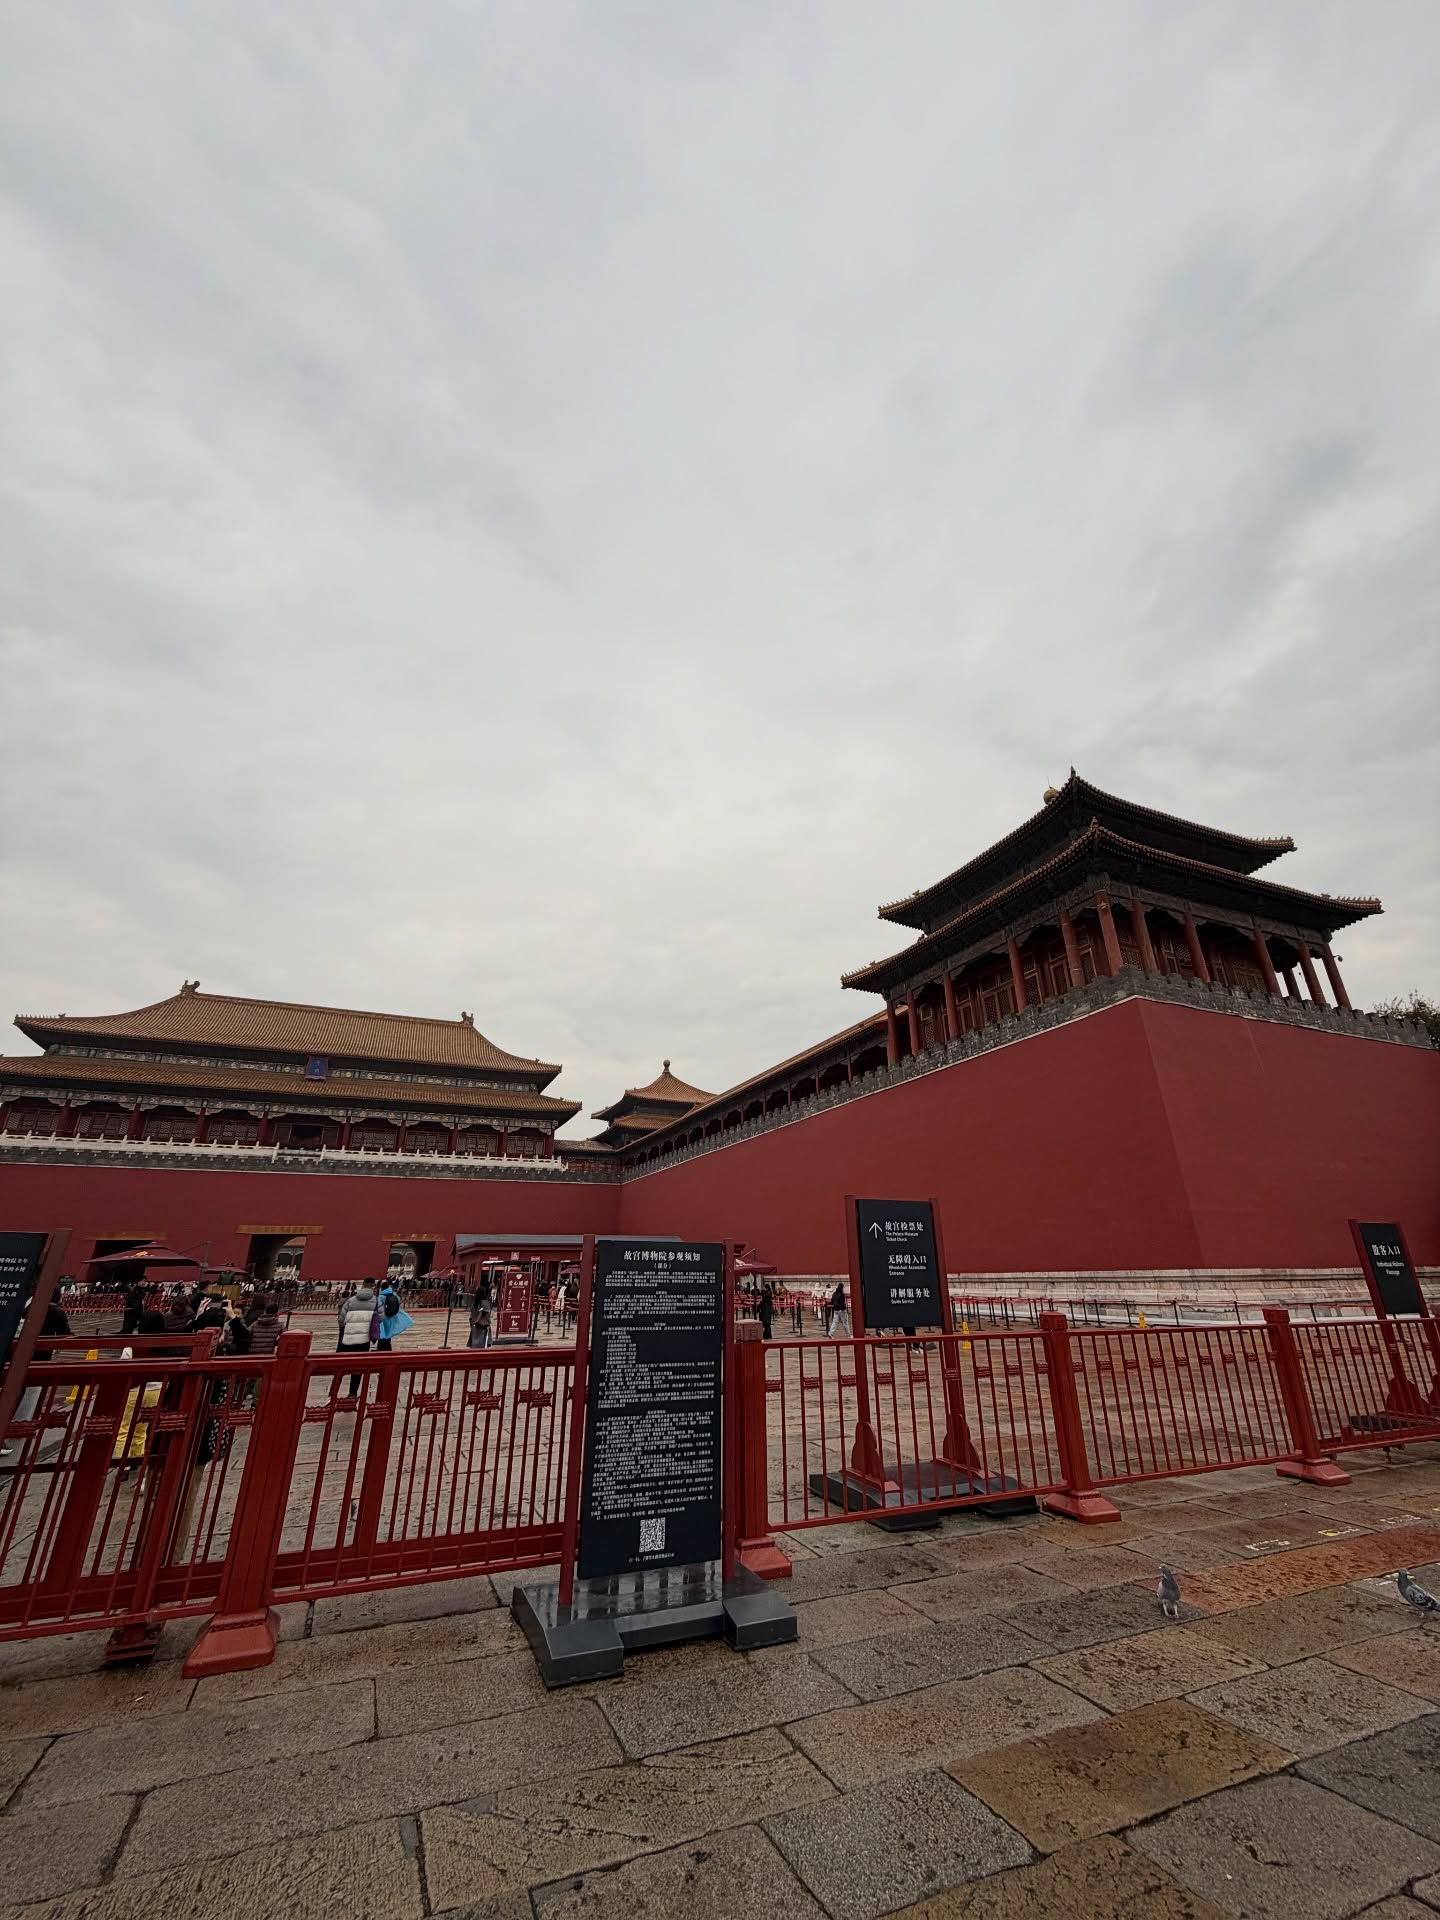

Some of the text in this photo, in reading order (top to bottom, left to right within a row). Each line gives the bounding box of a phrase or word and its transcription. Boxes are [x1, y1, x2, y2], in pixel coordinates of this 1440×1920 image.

[885, 1221, 923, 1231] 故宫检票处
[1372, 1244, 1400, 1255] 散客入口
[623, 1250, 701, 1262] 故宫博物院参观须知
[888, 1254, 927, 1264] 无障碍入口
[890, 1288, 931, 1298] 讲解服务处
